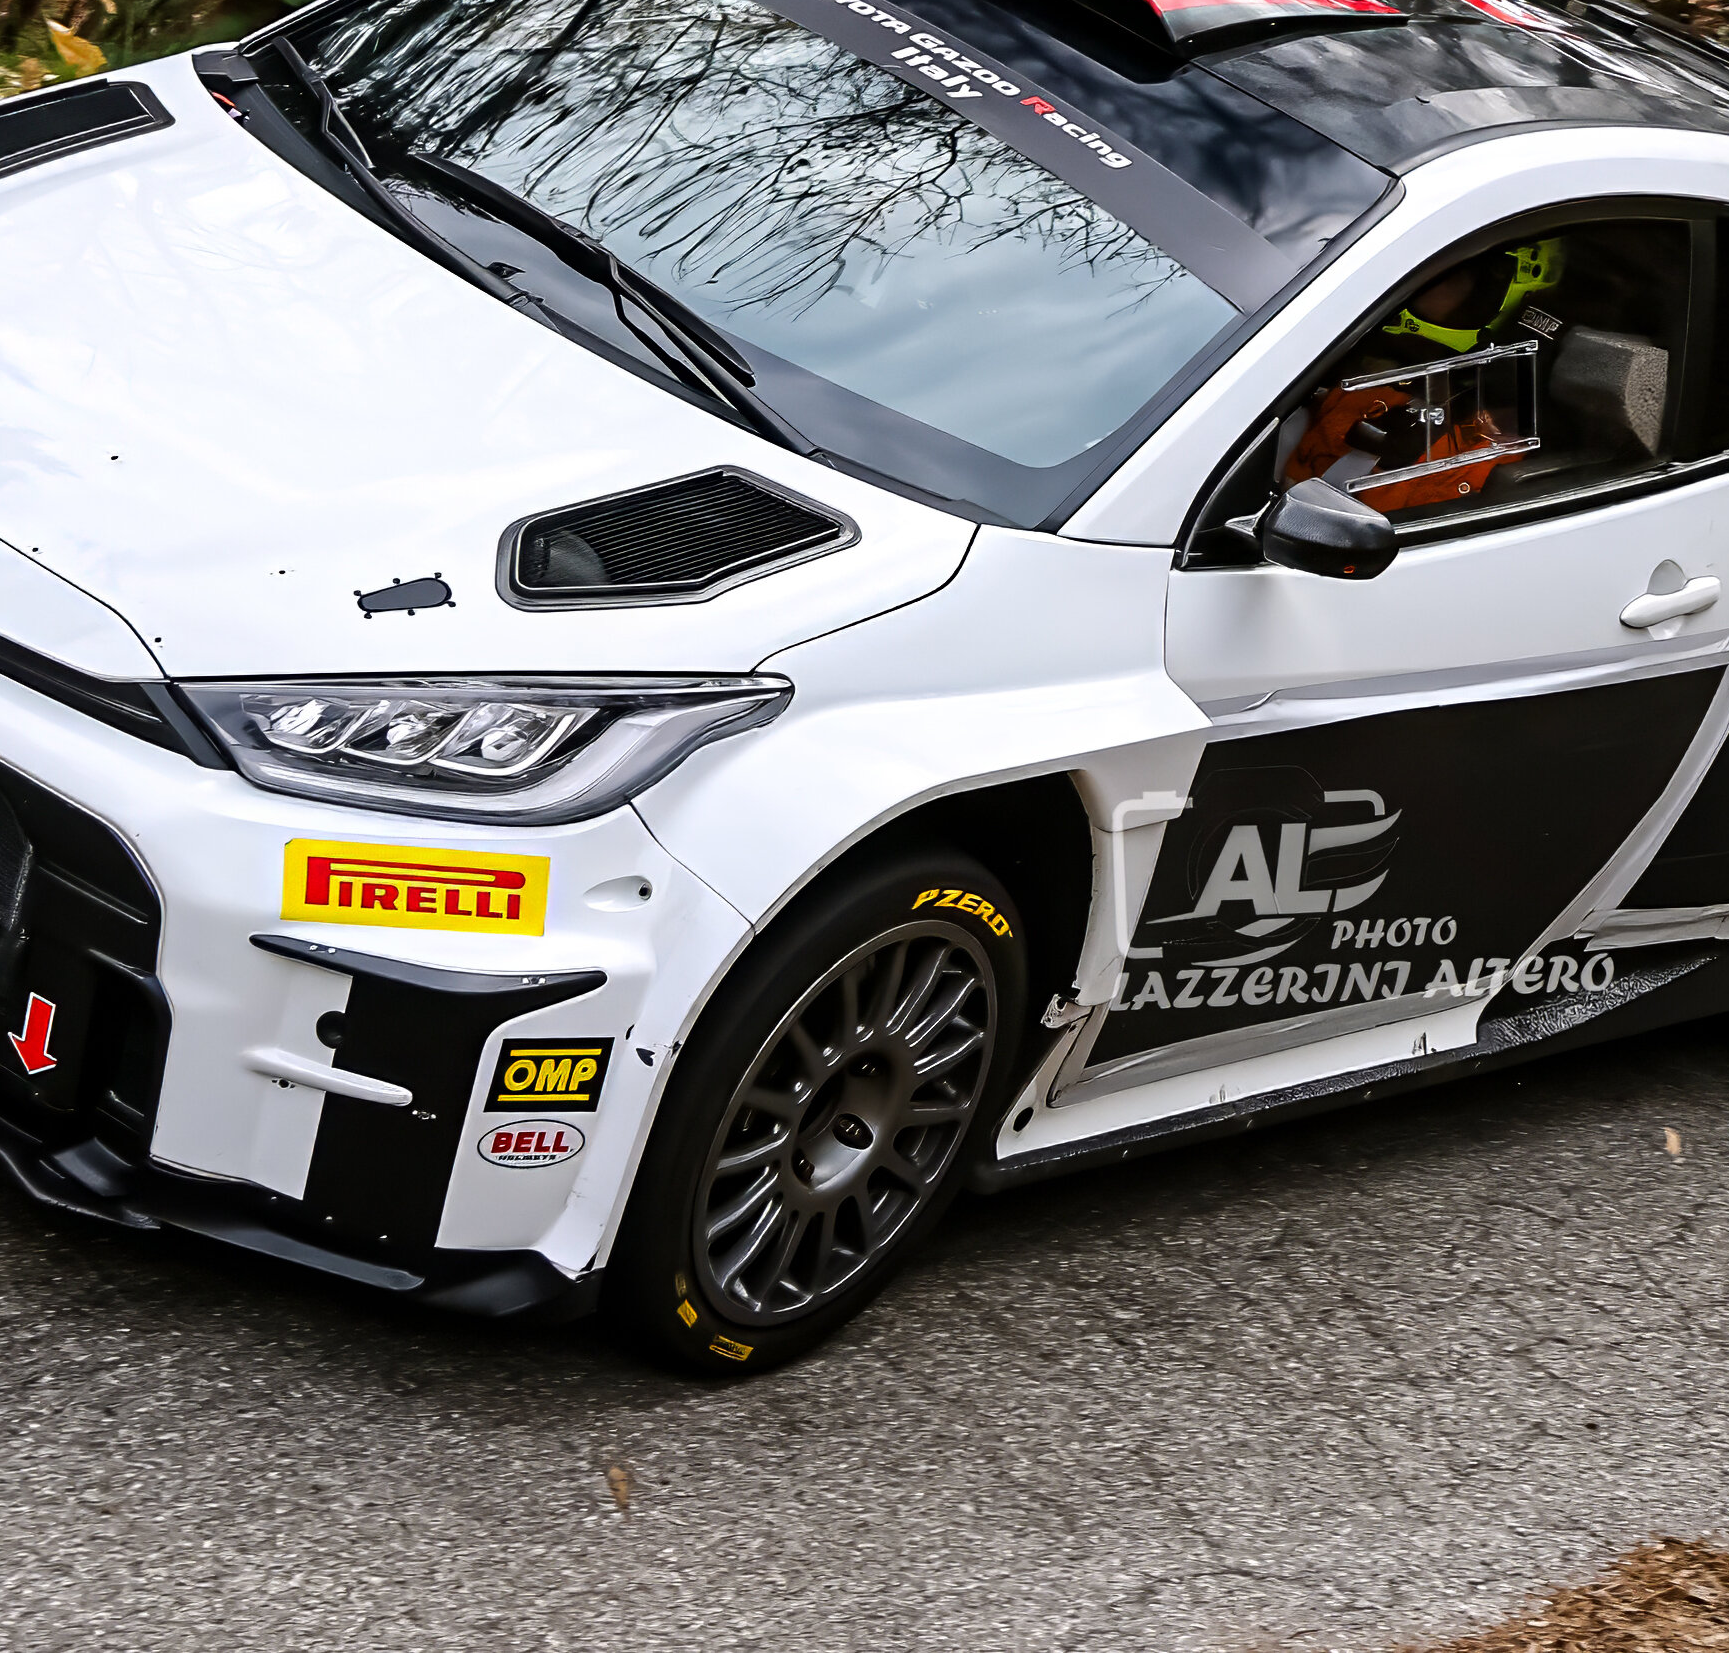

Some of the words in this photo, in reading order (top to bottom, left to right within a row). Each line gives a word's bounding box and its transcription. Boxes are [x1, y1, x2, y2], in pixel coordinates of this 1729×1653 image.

[891, 46, 983, 100] Italy
[909, 32, 1021, 97] GAZOO
[1020, 96, 1133, 169] Racing
[305, 856, 526, 920] PIRELLI
[504, 1057, 597, 1092] OMP
[491, 1131, 570, 1153] BELL
